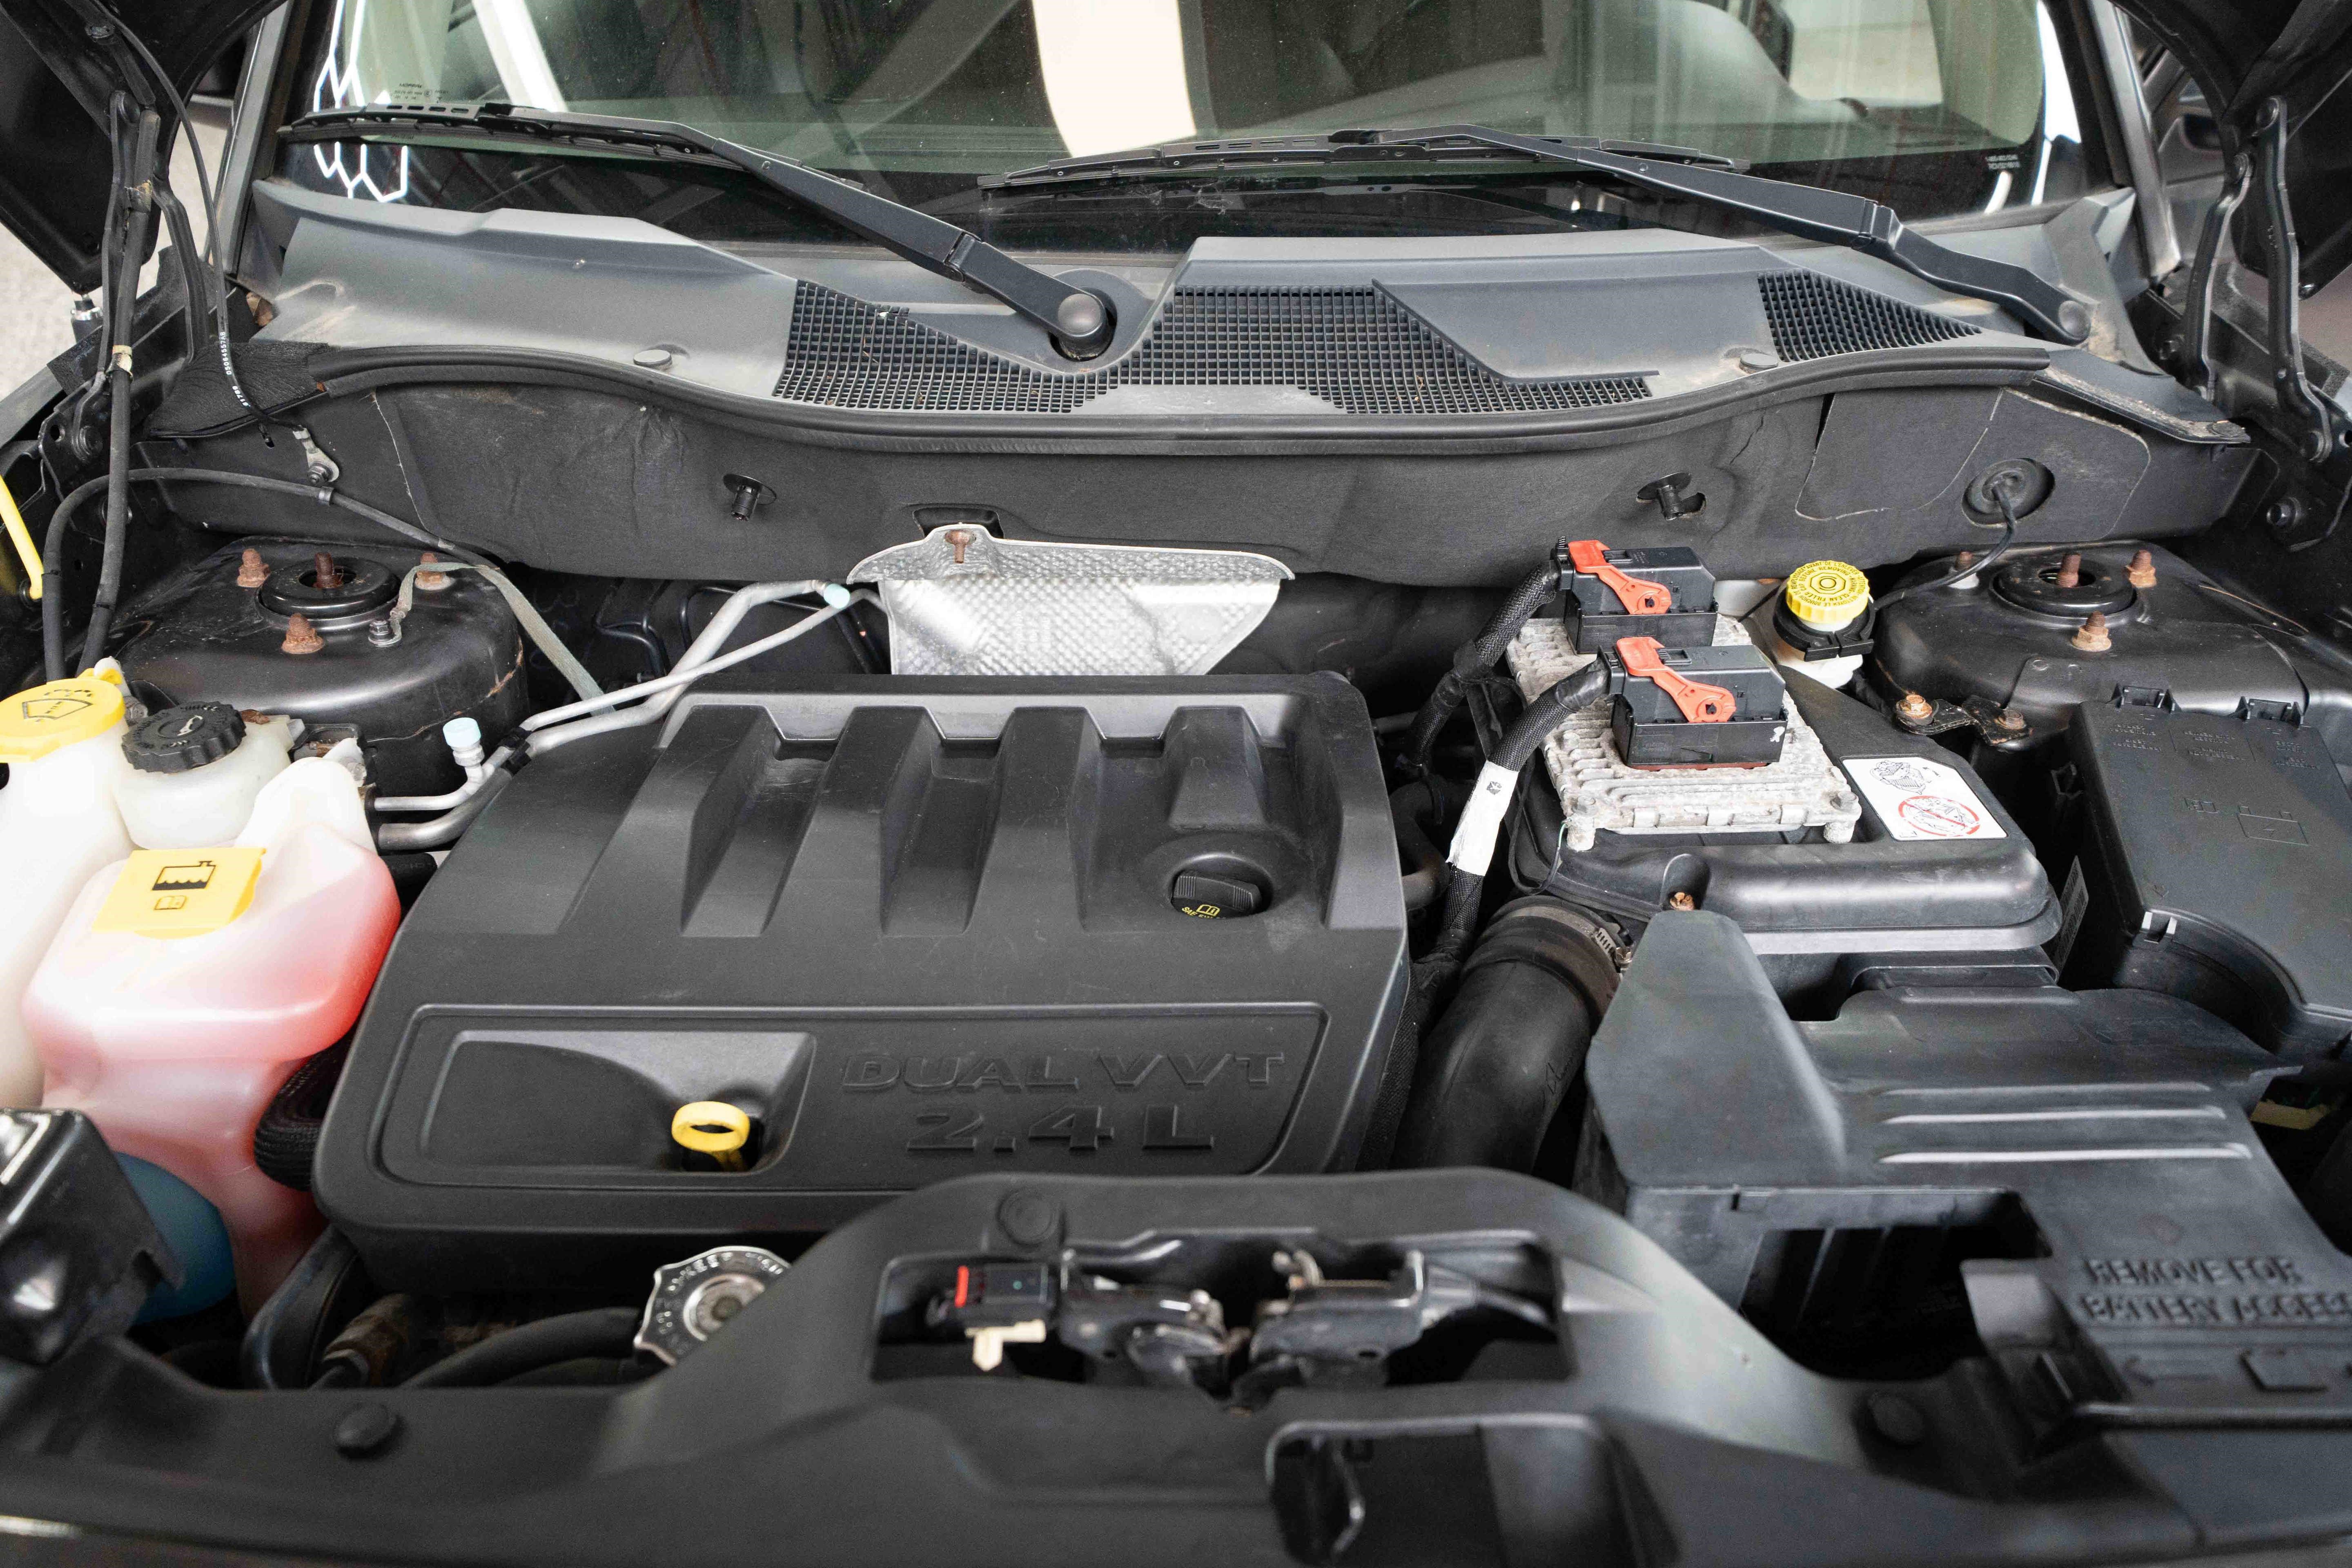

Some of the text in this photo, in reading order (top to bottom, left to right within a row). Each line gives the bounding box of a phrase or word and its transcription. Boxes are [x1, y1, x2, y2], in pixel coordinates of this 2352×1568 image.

[220, 332, 232, 375] 05064557AB
[1799, 568, 1815, 581] BEFORE
[1818, 566, 1850, 575] REMOVING
[1804, 592, 1826, 601] FILLER
[1830, 593, 1849, 601] CLEAN
[1182, 907, 1198, 916] SAE
[842, 1052, 1285, 1093] DUAL VVT
[2082, 1256, 2303, 1285] REMOVE FOR
[2078, 1294, 2221, 1324] BATTERY
